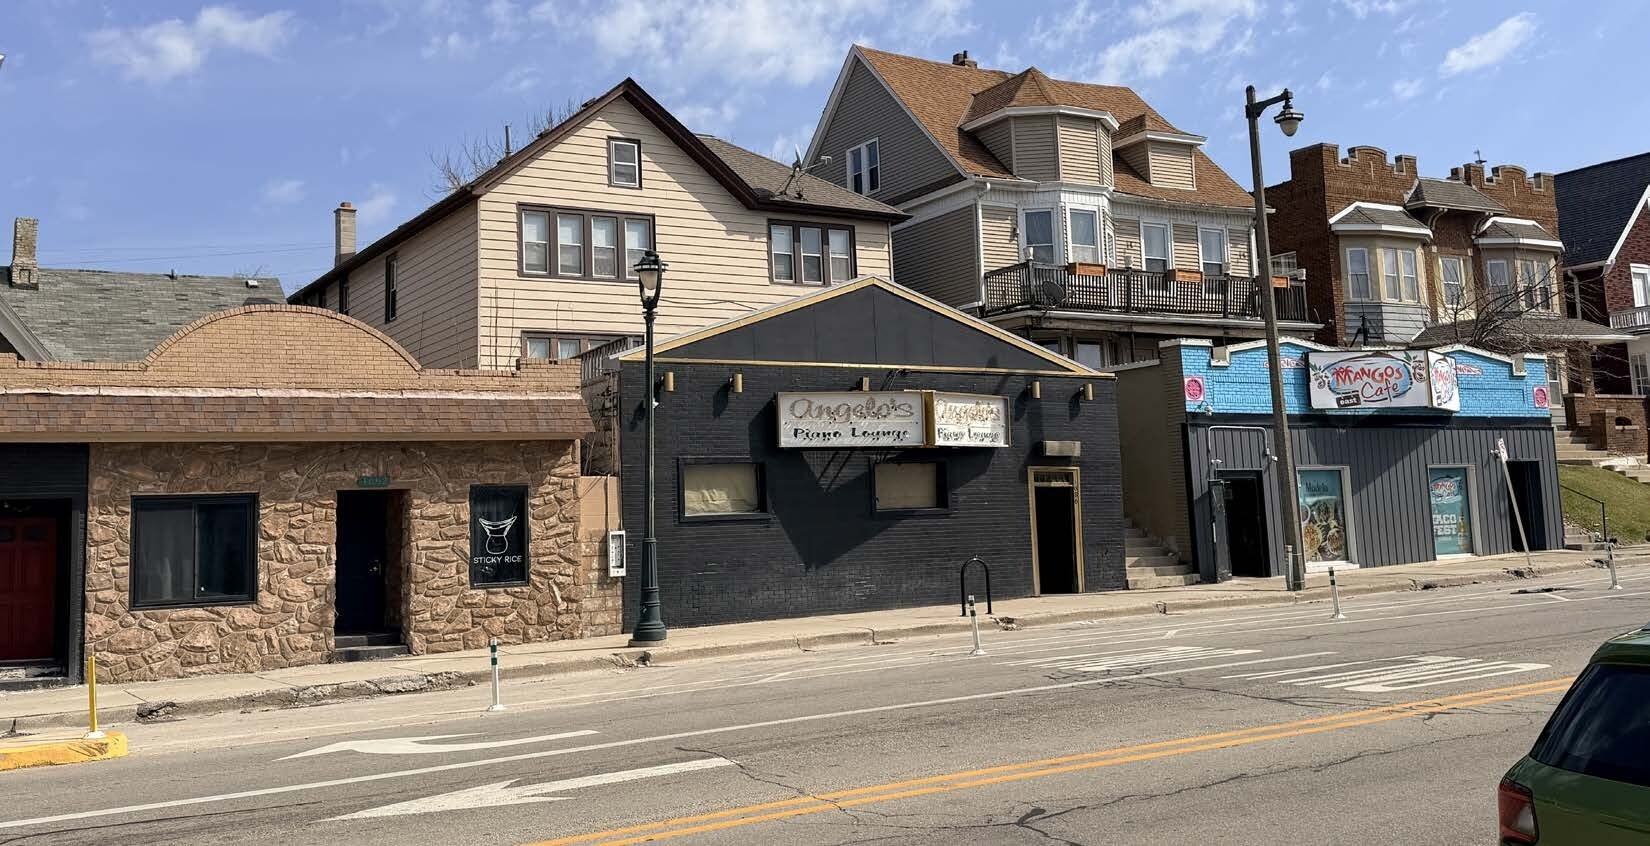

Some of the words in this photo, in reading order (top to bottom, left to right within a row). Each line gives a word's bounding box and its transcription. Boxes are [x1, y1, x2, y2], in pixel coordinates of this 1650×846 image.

[1332, 365, 1403, 387] MANGOS
[1361, 379, 1400, 402] Cafe
[793, 427, 842, 441] Piano
[851, 427, 910, 442] Lounge
[473, 556, 503, 564] STICKY
[504, 555, 522, 563] RICE
